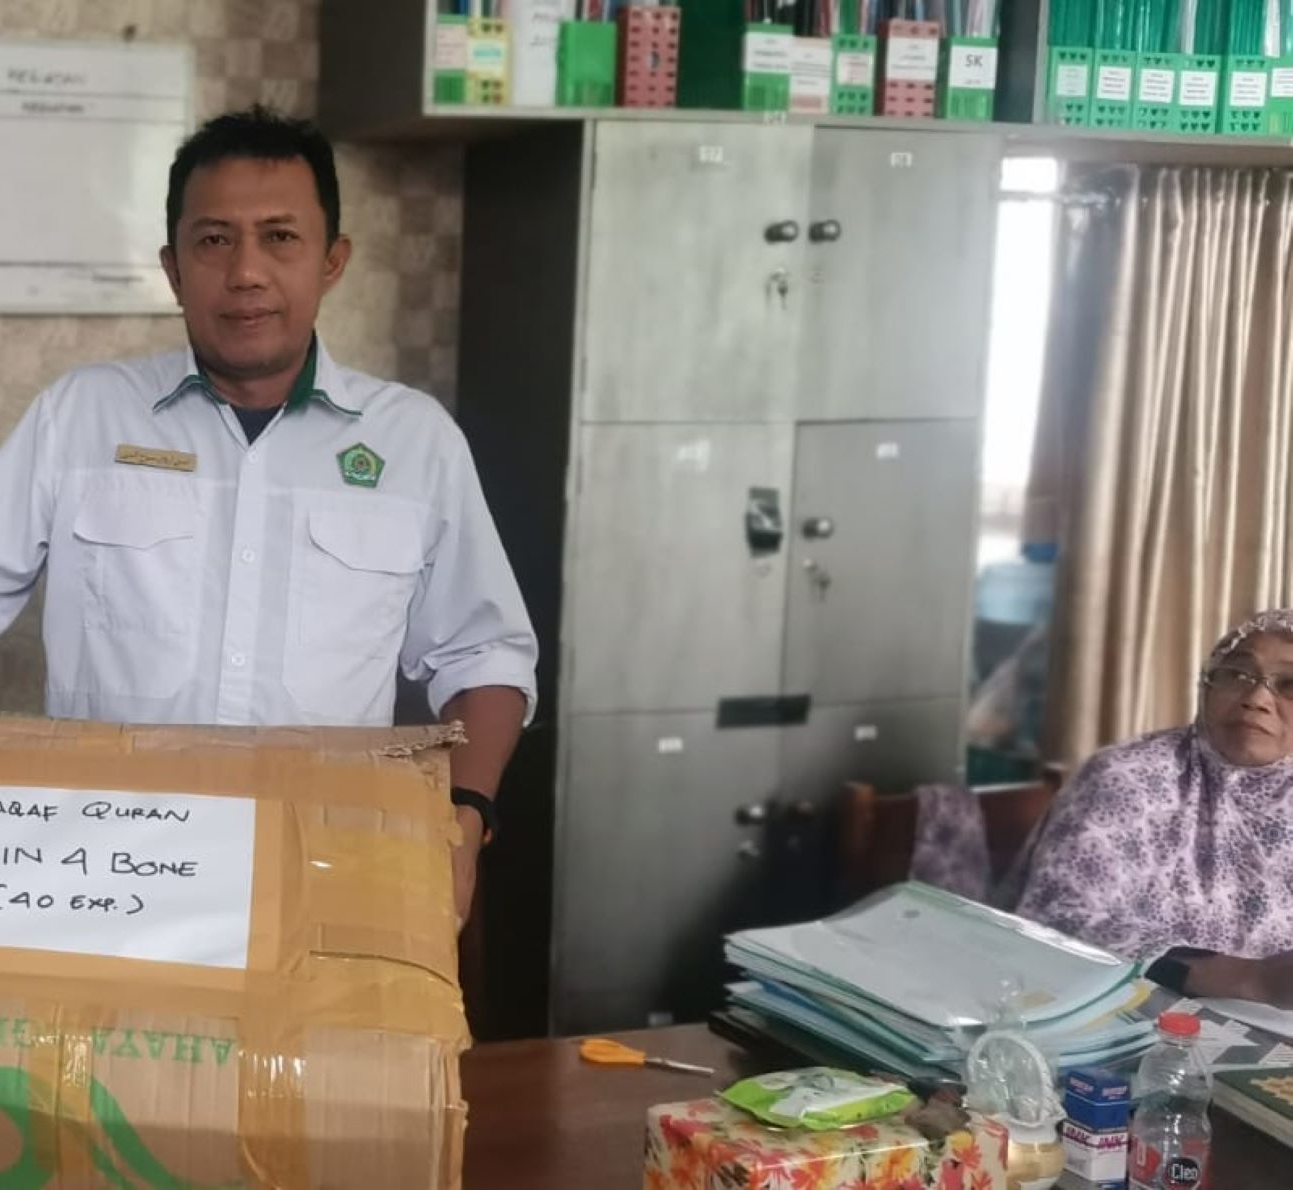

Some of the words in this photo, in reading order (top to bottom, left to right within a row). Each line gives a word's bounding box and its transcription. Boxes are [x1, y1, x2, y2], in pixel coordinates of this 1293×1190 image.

[965, 54, 983, 68] SK
[81, 801, 190, 823] QURAN
[60, 847, 88, 875] 4
[110, 852, 198, 877] BONE
[92, 1026, 237, 1066] AHAYA
